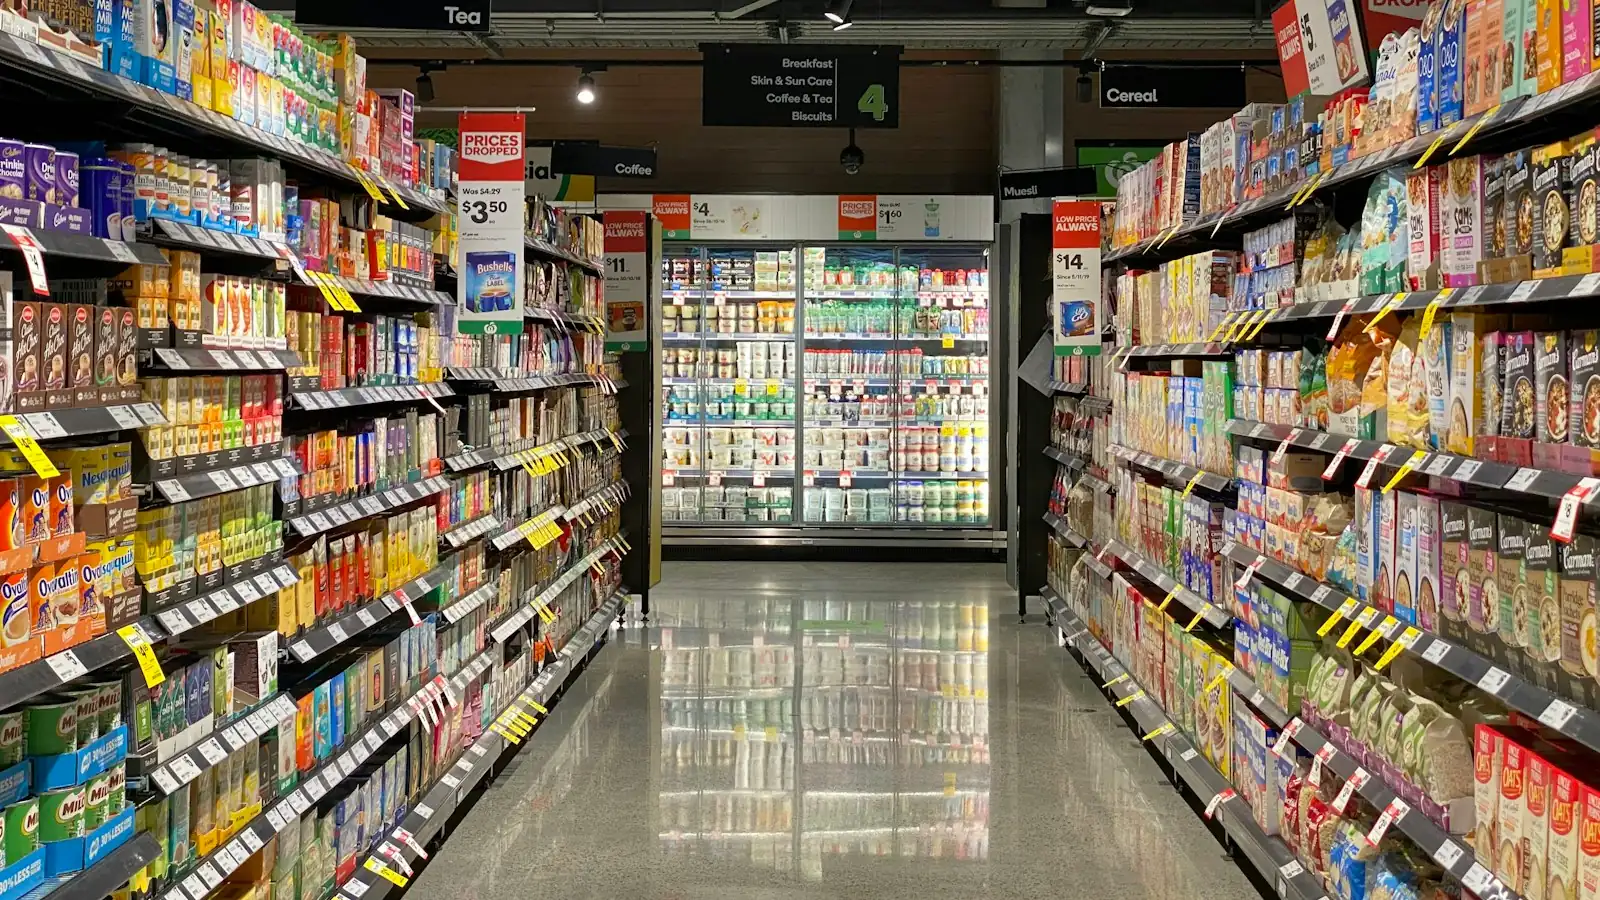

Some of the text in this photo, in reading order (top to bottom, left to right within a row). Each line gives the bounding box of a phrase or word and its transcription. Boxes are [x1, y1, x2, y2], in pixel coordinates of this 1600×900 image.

[444, 6, 480, 24] Tea
[782, 58, 833, 69] Breakfast
[751, 75, 833, 87] Skin & Sun Care
[766, 93, 833, 104] Coffee & Tea
[1106, 87, 1158, 103] Cereal
[857, 83, 889, 121] 4
[792, 111, 833, 121] Biscuits
[464, 135, 519, 147] PRICES
[464, 147, 519, 156] DROPPED
[614, 162, 652, 176] Coffee
[1003, 184, 1038, 198] Muesli
[655, 207, 689, 215] ALWAYS
[694, 202, 710, 217] $4
[843, 202, 873, 210] PRICES
[605, 222, 622, 230] LOW
[1056, 215, 1098, 224] LOW PRICE
[605, 229, 644, 238] ALWAYS
[1056, 222, 1098, 232] ALWAYS
[477, 261, 513, 275] Bushells
[606, 257, 625, 273] $11
[1056, 254, 1084, 270] $14
[486, 279, 504, 288] LABEL
[1476, 751, 1490, 773] OATS
[1503, 767, 1521, 788] OATS
[1528, 782, 1547, 802] OATS
[1553, 797, 1572, 820] OATS
